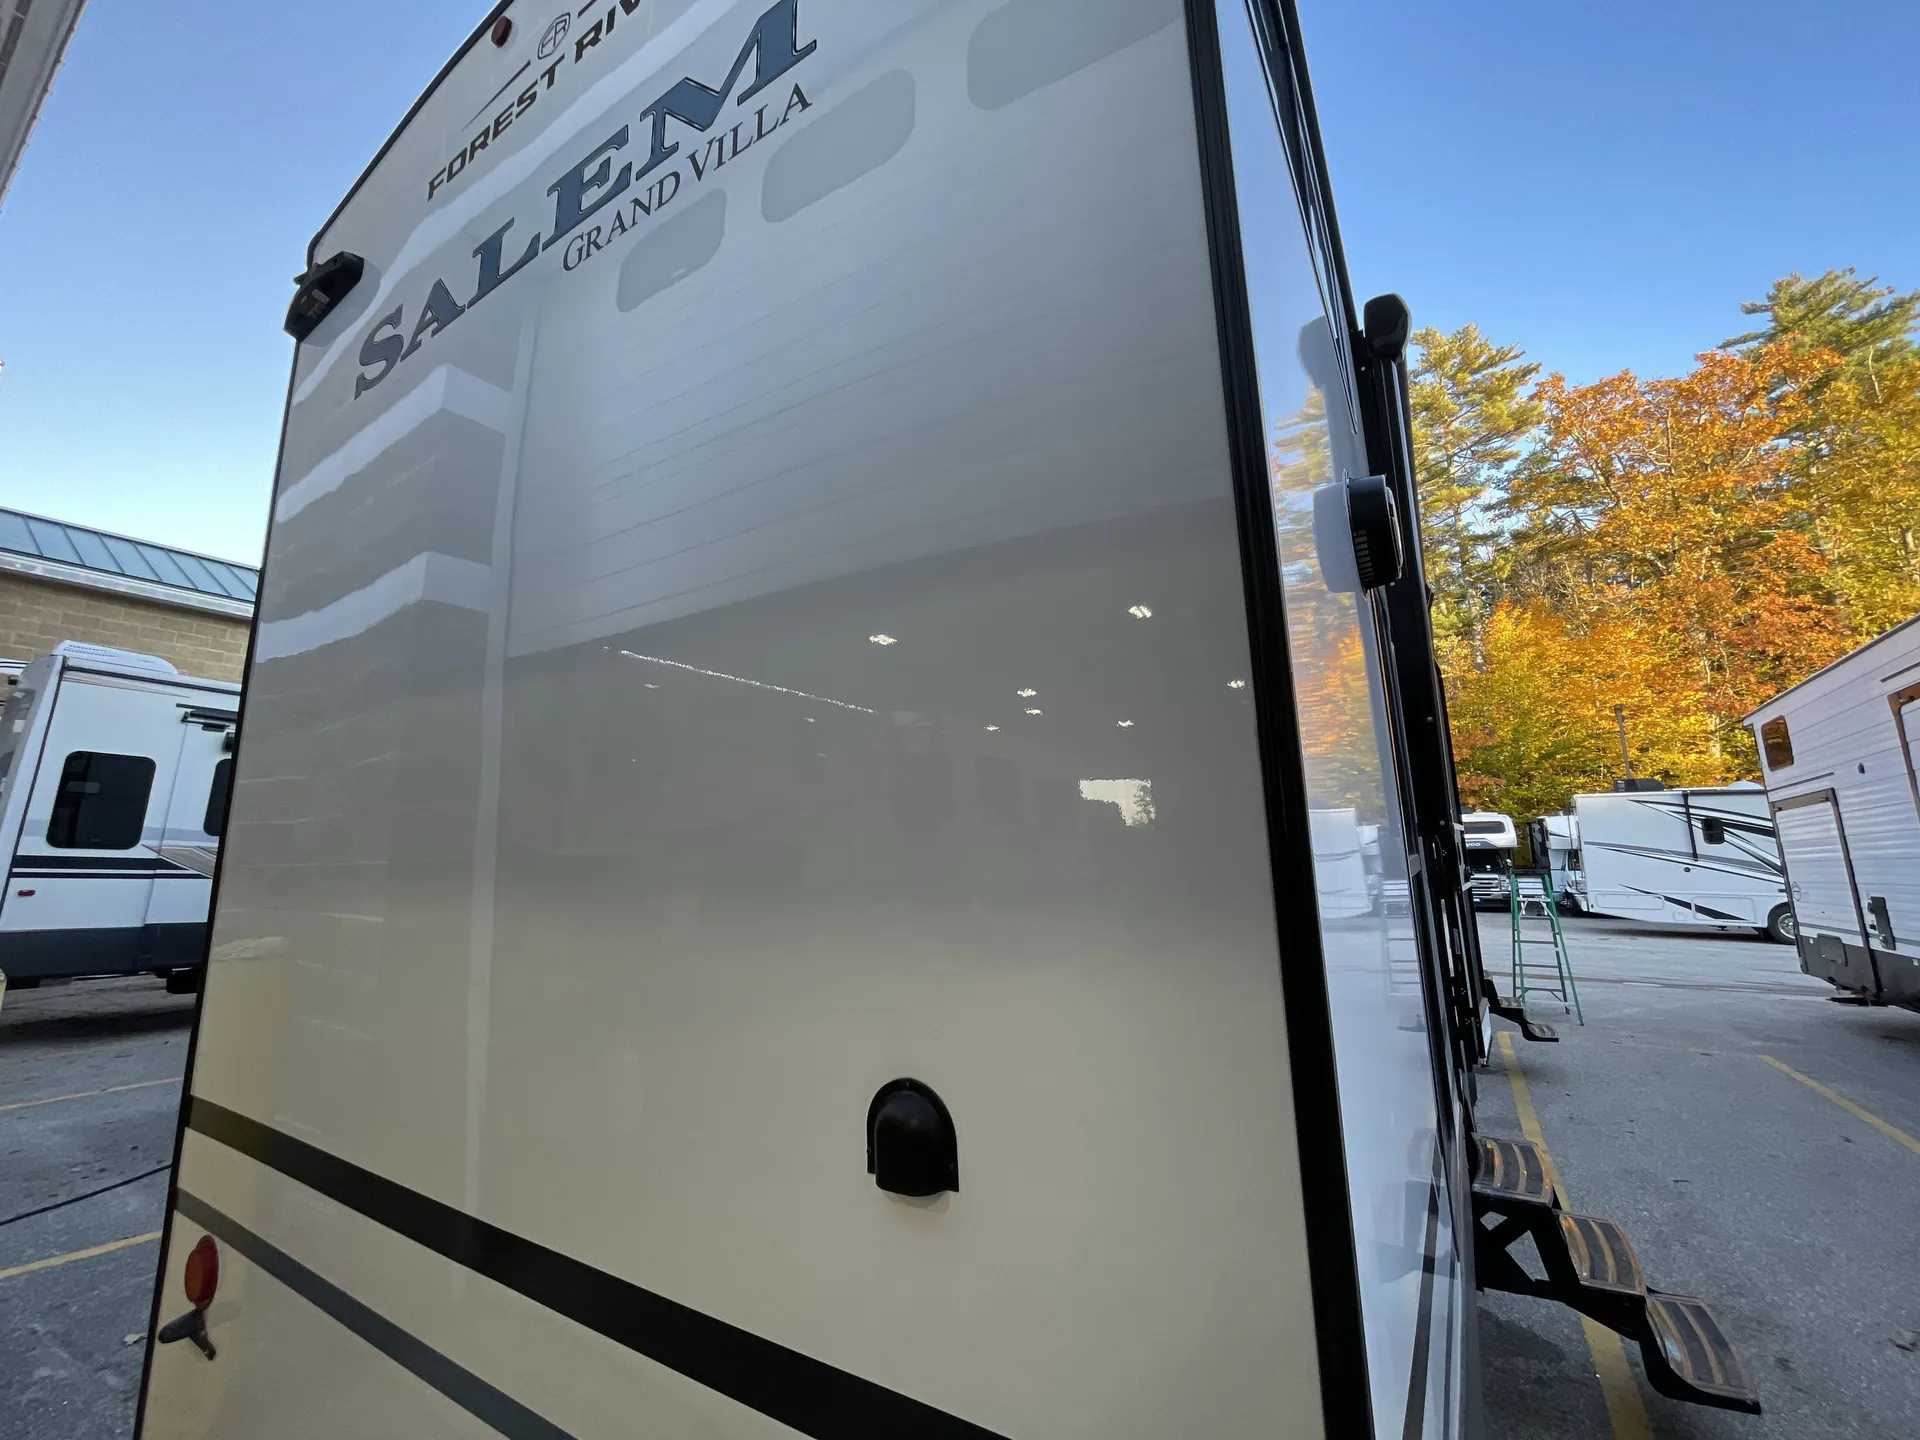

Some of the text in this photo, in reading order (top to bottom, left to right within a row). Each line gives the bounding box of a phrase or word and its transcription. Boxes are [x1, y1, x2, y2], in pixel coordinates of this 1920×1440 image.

[354, 0, 818, 401] SALEM
[427, 53, 566, 202] FOREST
[562, 82, 813, 272] GRAND VILLA
